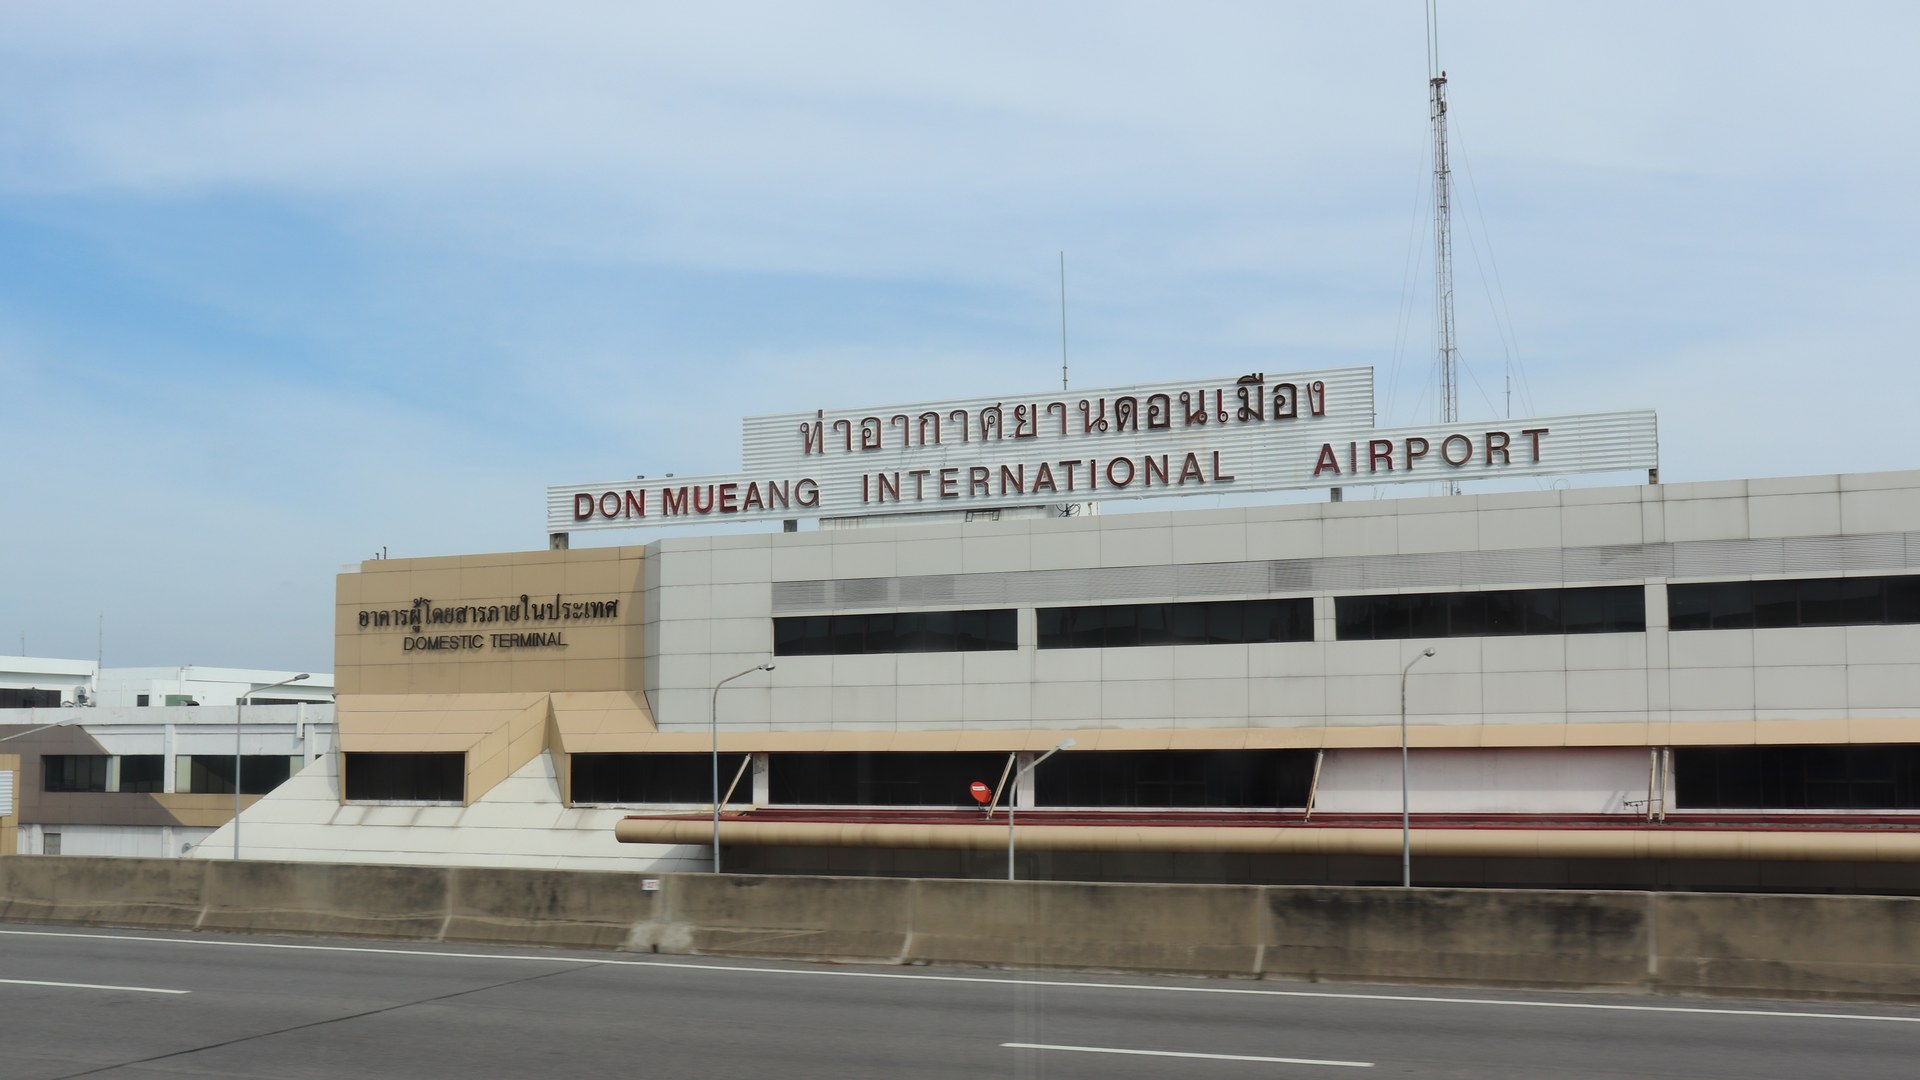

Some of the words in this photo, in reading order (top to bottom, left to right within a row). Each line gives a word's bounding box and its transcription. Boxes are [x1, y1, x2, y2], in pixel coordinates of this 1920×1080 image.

[800, 372, 1326, 455] ท่าอากาศยานดอนเมือง
[574, 489, 647, 522] DON
[663, 478, 821, 516] MUEANG
[863, 450, 1235, 504] INTERNATIONAL
[1313, 428, 1549, 476] AIRPORT
[358, 594, 618, 633] อาคารผู้โดยสารภายในประเทศ
[404, 634, 483, 651] DOMESTIC
[490, 632, 568, 649] TERMINAL
